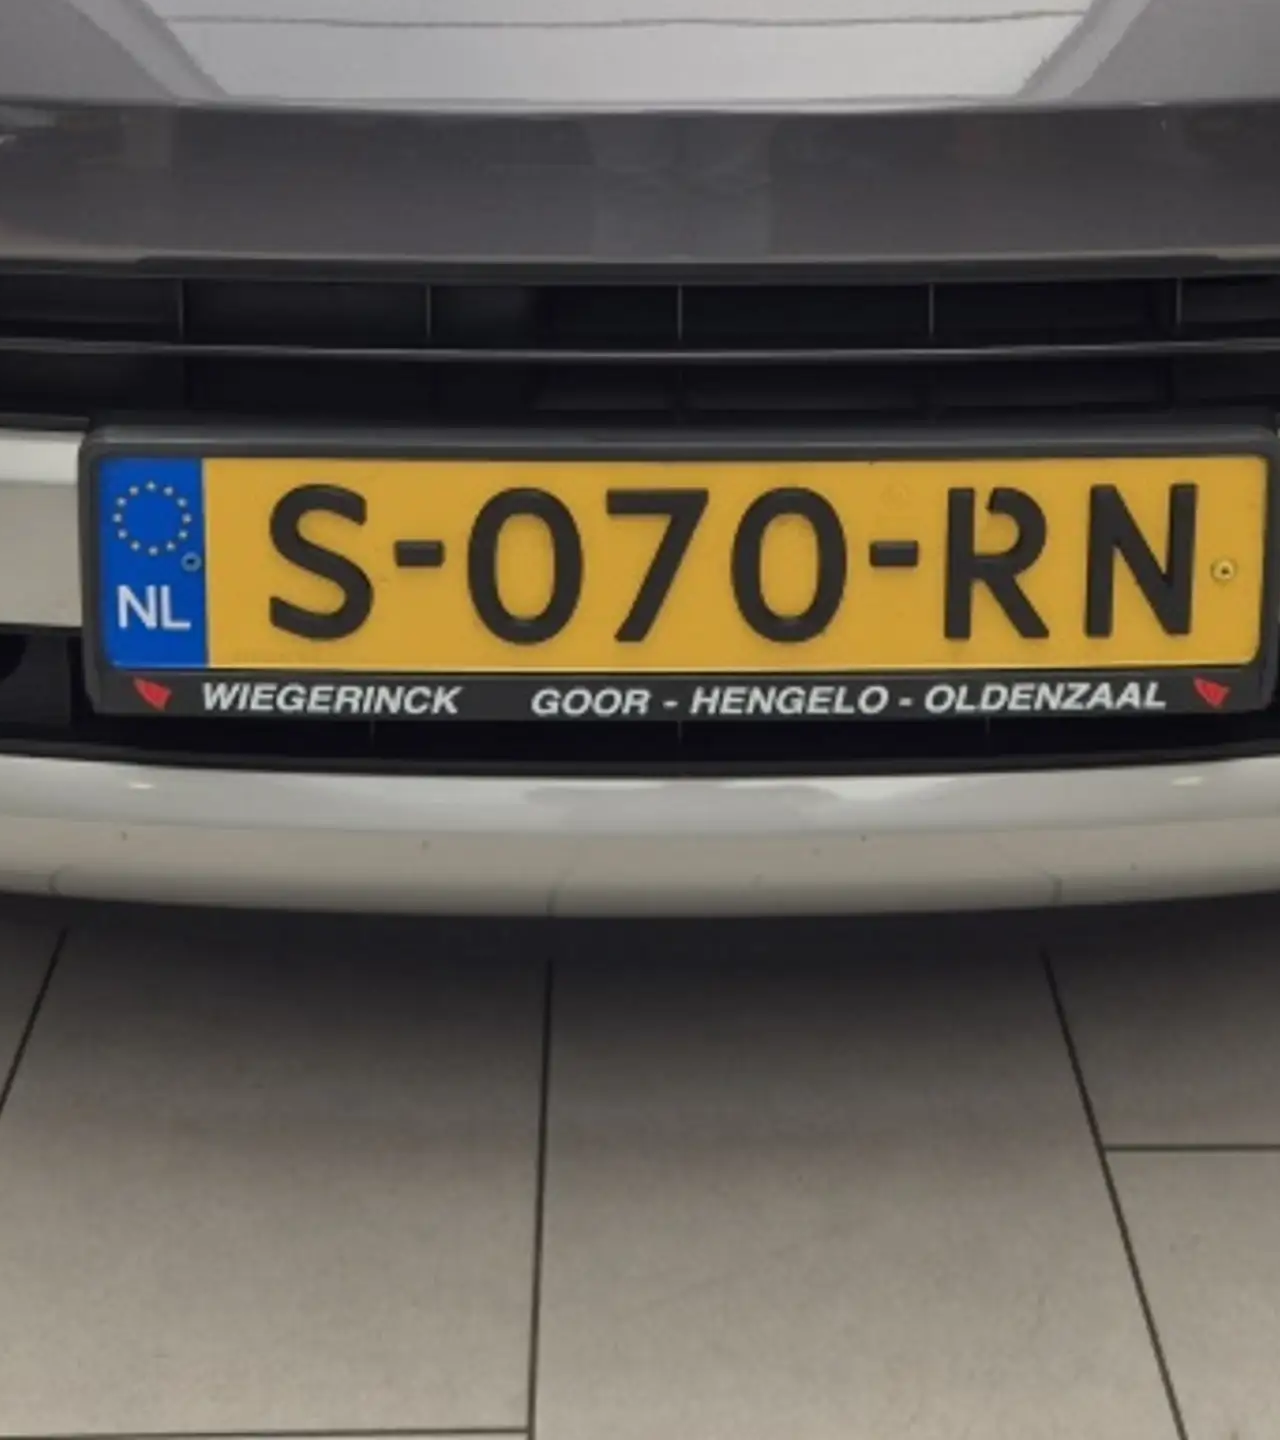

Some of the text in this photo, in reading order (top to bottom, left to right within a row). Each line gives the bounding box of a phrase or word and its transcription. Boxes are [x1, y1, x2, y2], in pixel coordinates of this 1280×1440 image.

[269, 483, 1198, 642] S-070-RN
[117, 584, 192, 630] NL
[202, 682, 463, 714] WIEGERINCK
[531, 687, 651, 716] GOOR
[690, 685, 889, 715] HENGELO
[924, 681, 1168, 714] OLDENZAAL
